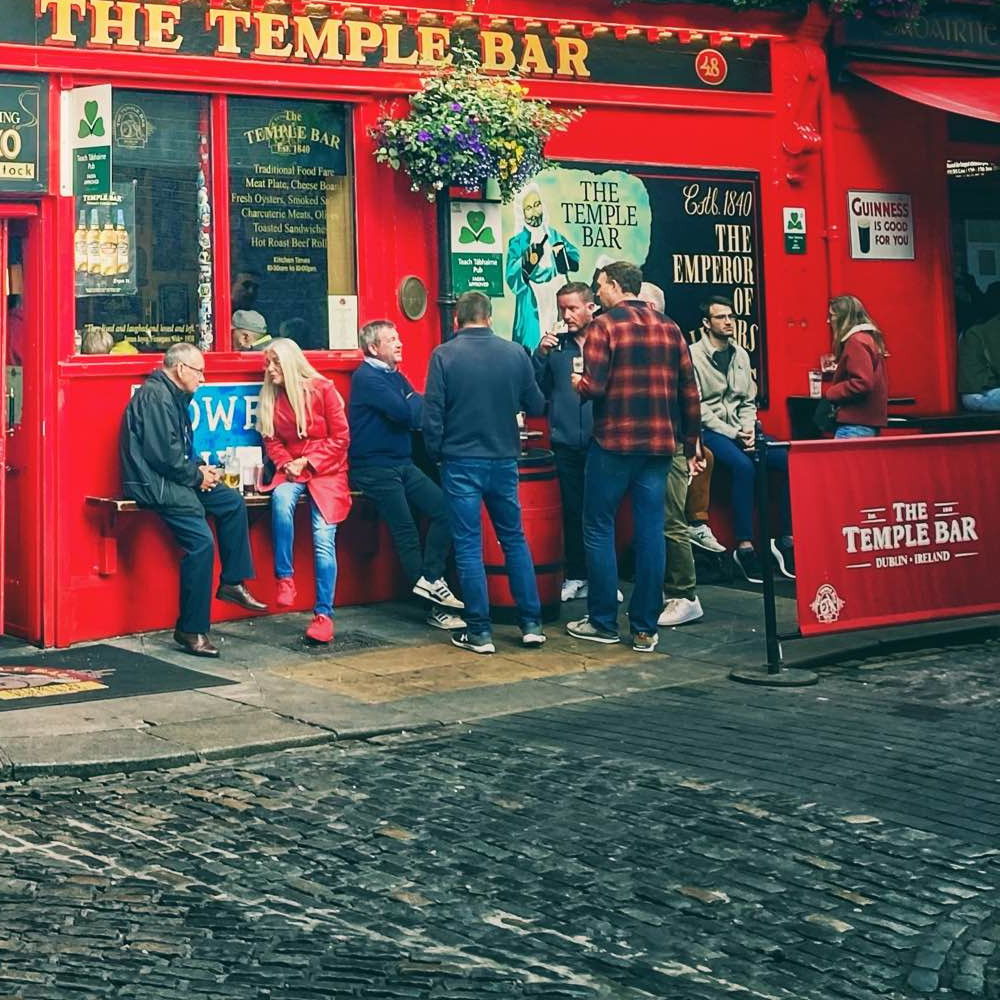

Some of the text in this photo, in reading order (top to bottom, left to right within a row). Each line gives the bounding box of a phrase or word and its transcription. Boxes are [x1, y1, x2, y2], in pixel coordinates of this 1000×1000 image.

[207, 8, 453, 66] TEMPLE
[480, 30, 590, 77] BAR
[700, 56, 720, 77] 48
[285, 110, 302, 121] The
[243, 124, 341, 150] TEMPLE BAR
[253, 163, 335, 177] Traditional Food Fare
[245, 178, 266, 188] Meat
[291, 181, 318, 190] Cheese
[580, 180, 620, 203] THE
[231, 193, 252, 203] Fresh
[288, 195, 318, 204] Smoked
[724, 190, 752, 217] 1840
[851, 197, 909, 219] GUINNESS
[561, 202, 638, 226] TEMPLE
[253, 222, 282, 233] Toasted
[582, 225, 622, 249] BAR
[874, 221, 908, 232] IS GOOD
[251, 237, 266, 247] Hot
[268, 238, 290, 248] Roast
[292, 238, 309, 248] Beef
[715, 223, 752, 253] THE
[876, 235, 909, 246] FOR YOU
[672, 254, 755, 285] EMPEROR
[733, 287, 754, 316] OF
[892, 502, 928, 522] THE
[842, 516, 979, 554] TEMPLE BAR
[875, 551, 951, 568] DUBLIN IRELAND
